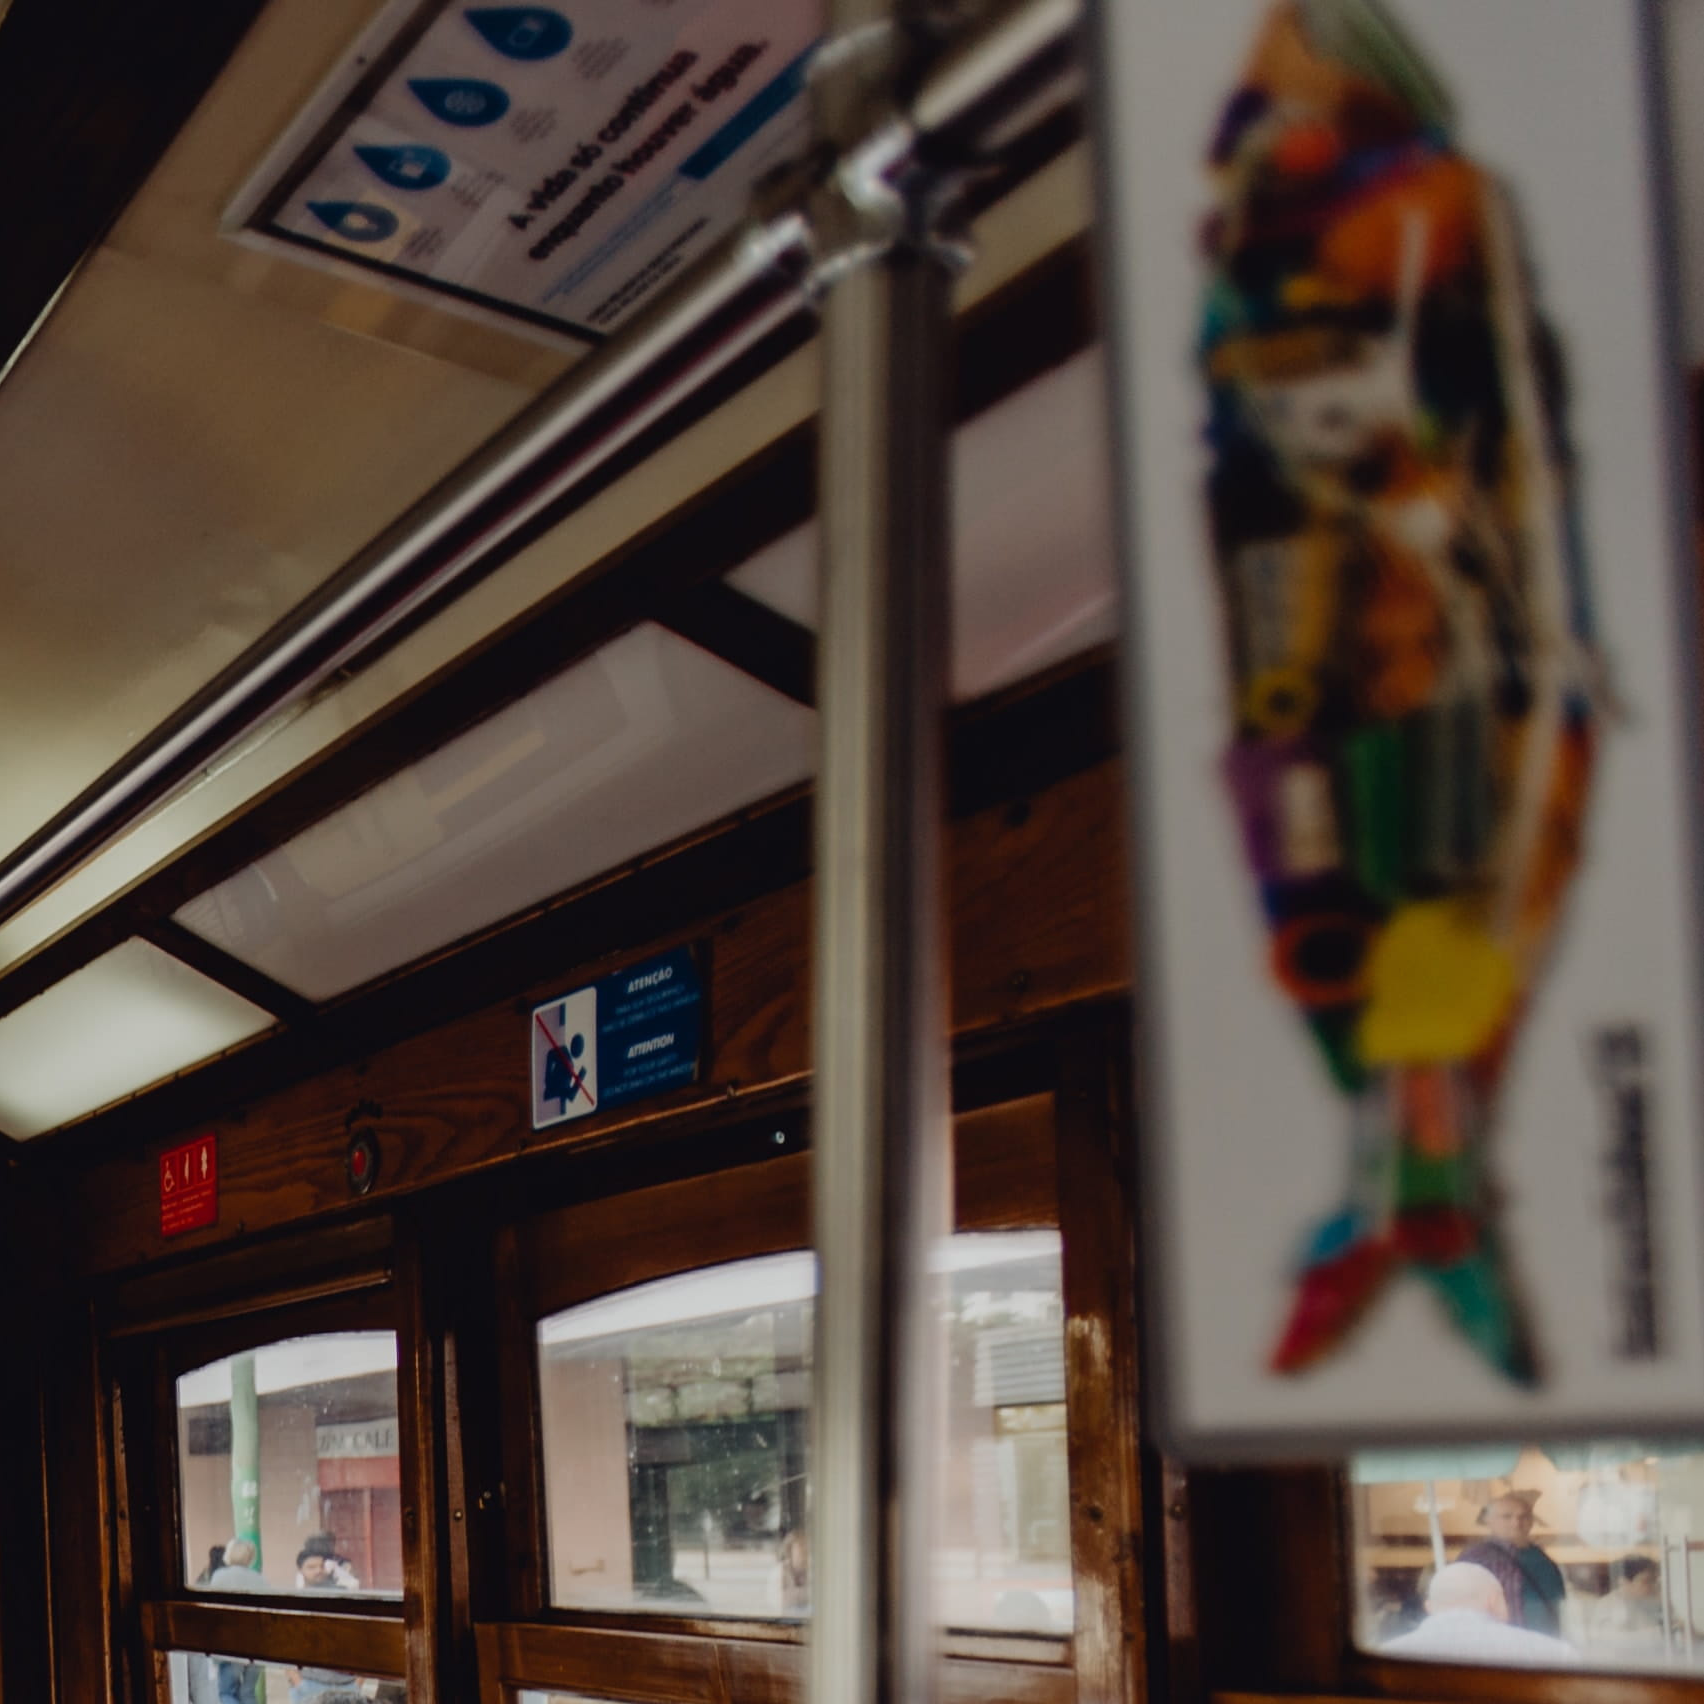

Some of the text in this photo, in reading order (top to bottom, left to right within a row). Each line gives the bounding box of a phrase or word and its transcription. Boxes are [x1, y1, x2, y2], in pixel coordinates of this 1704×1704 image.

[508, 213, 535, 230] A
[526, 168, 578, 211] vida
[570, 142, 603, 169] só
[597, 50, 698, 143] continua
[528, 173, 624, 261] enquanto
[611, 101, 698, 175] houver
[627, 966, 673, 994] ATENÇÃO
[627, 1032, 675, 1059] ATTENTION
